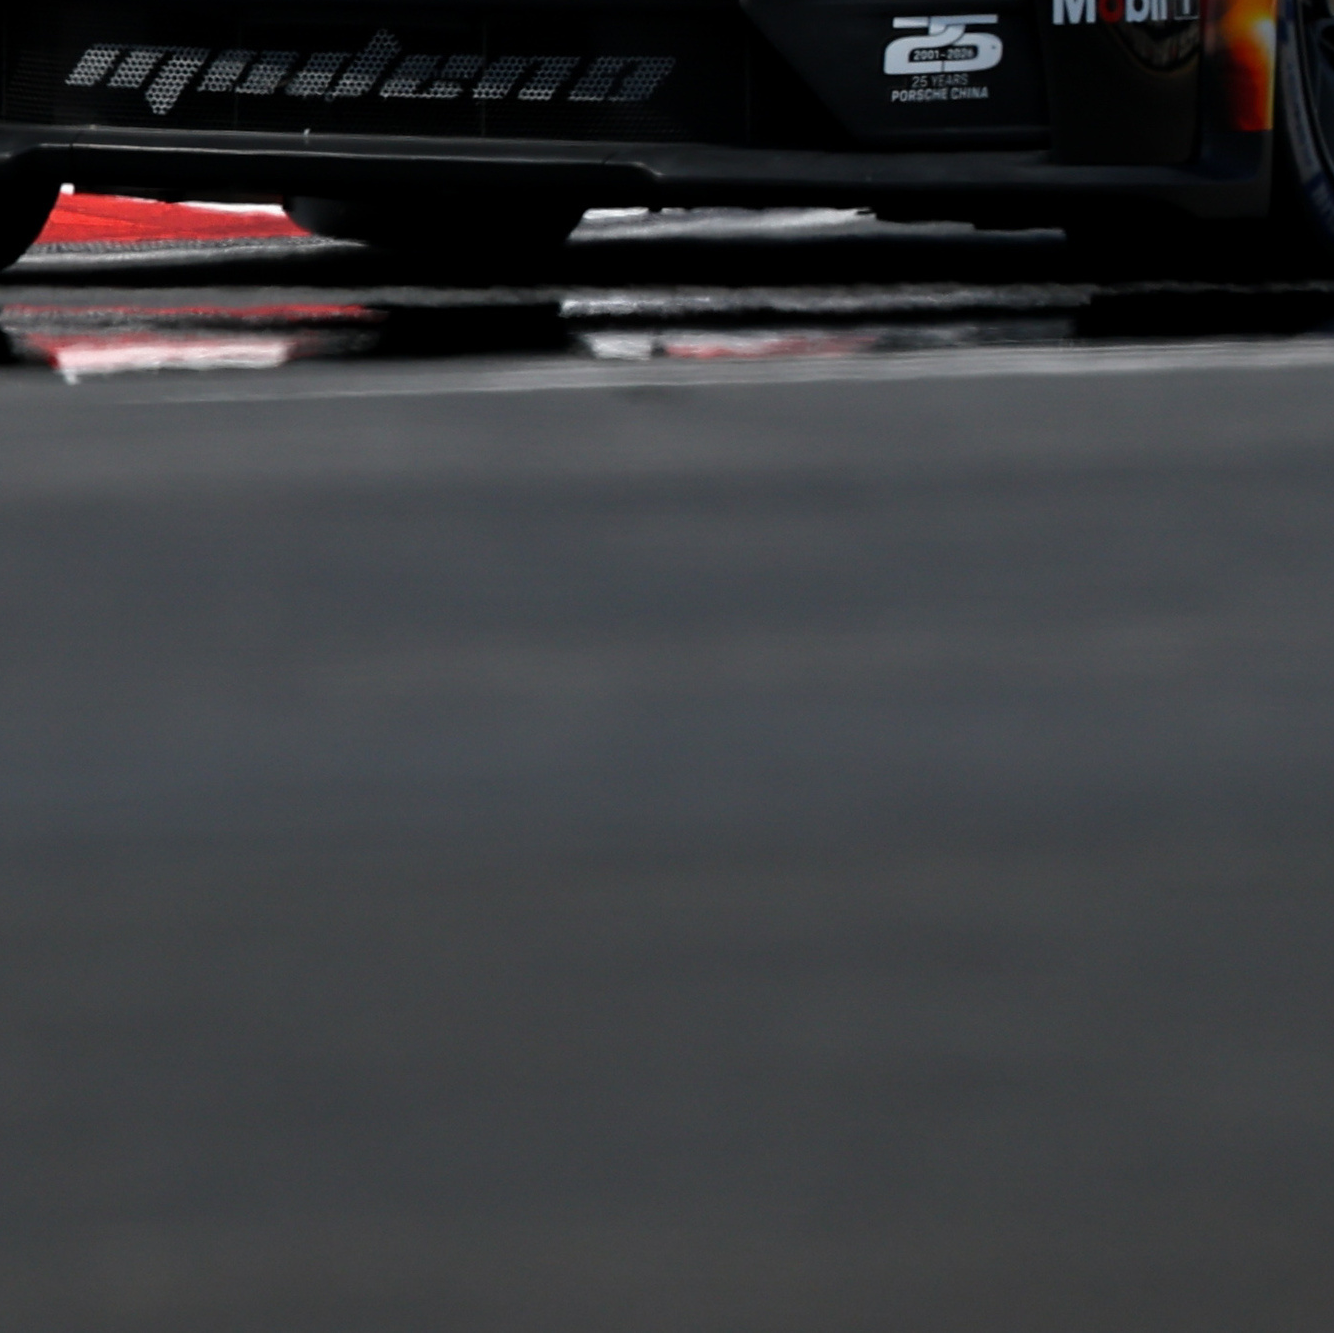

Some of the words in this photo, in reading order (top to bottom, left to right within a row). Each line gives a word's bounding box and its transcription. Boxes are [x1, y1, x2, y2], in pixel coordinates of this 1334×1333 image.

[910, 74, 929, 89] 25
[931, 72, 969, 87] YEARS
[891, 88, 949, 102] PORSCHE
[950, 86, 990, 99] CHINA
